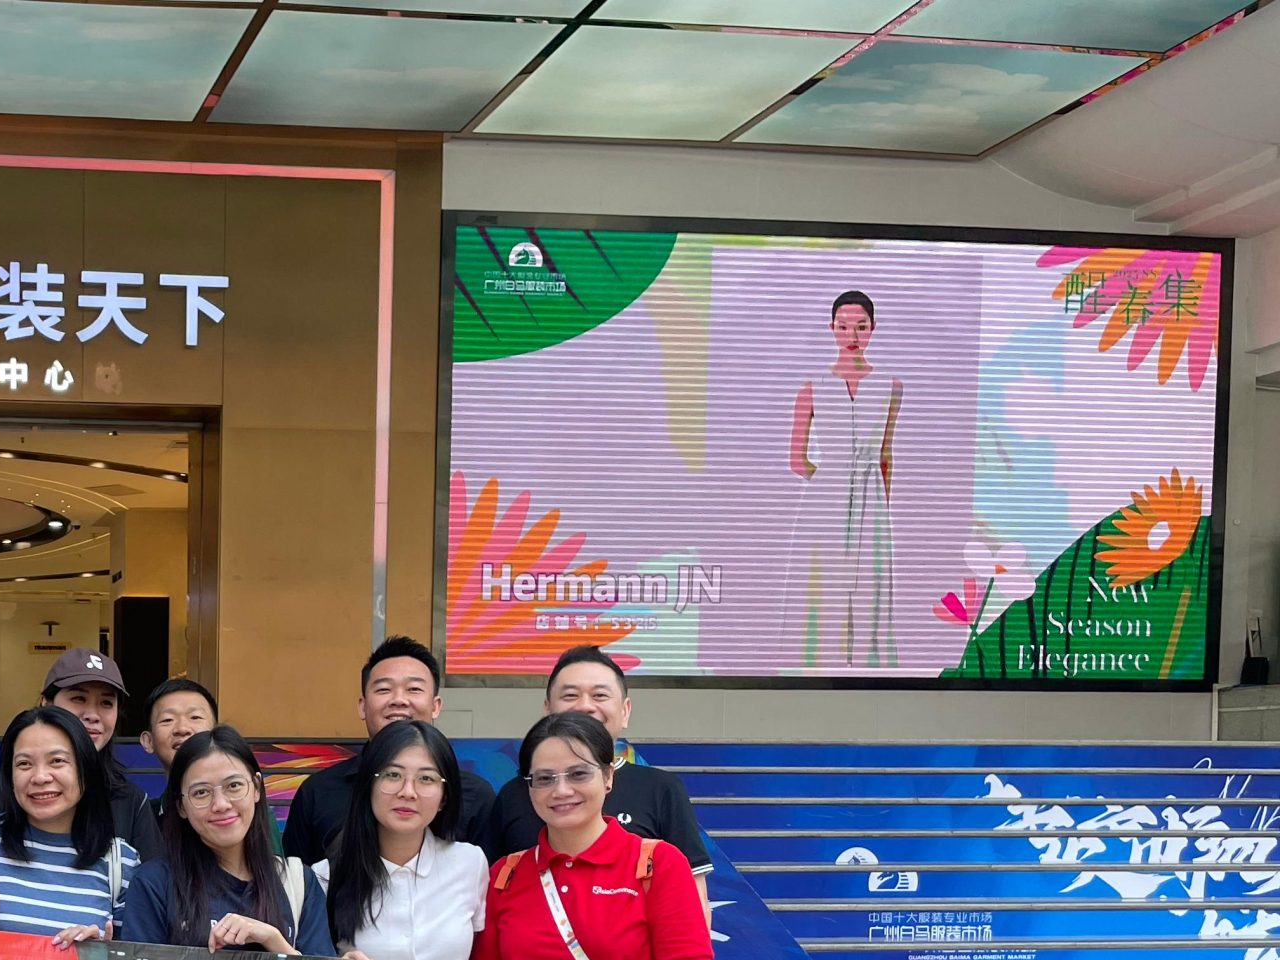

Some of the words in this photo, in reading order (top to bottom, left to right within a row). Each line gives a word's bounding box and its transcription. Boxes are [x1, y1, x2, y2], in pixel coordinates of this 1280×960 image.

[1062, 269, 1202, 326] 醒春集
[481, 563, 668, 603] Hermann
[674, 565, 722, 614] JN
[1086, 576, 1154, 603] New
[1046, 611, 1152, 637] Season
[1018, 644, 1150, 677] Elegance
[868, 911, 993, 923] 中国十大服装专业市场
[869, 925, 992, 942] 广州白马服装市场
